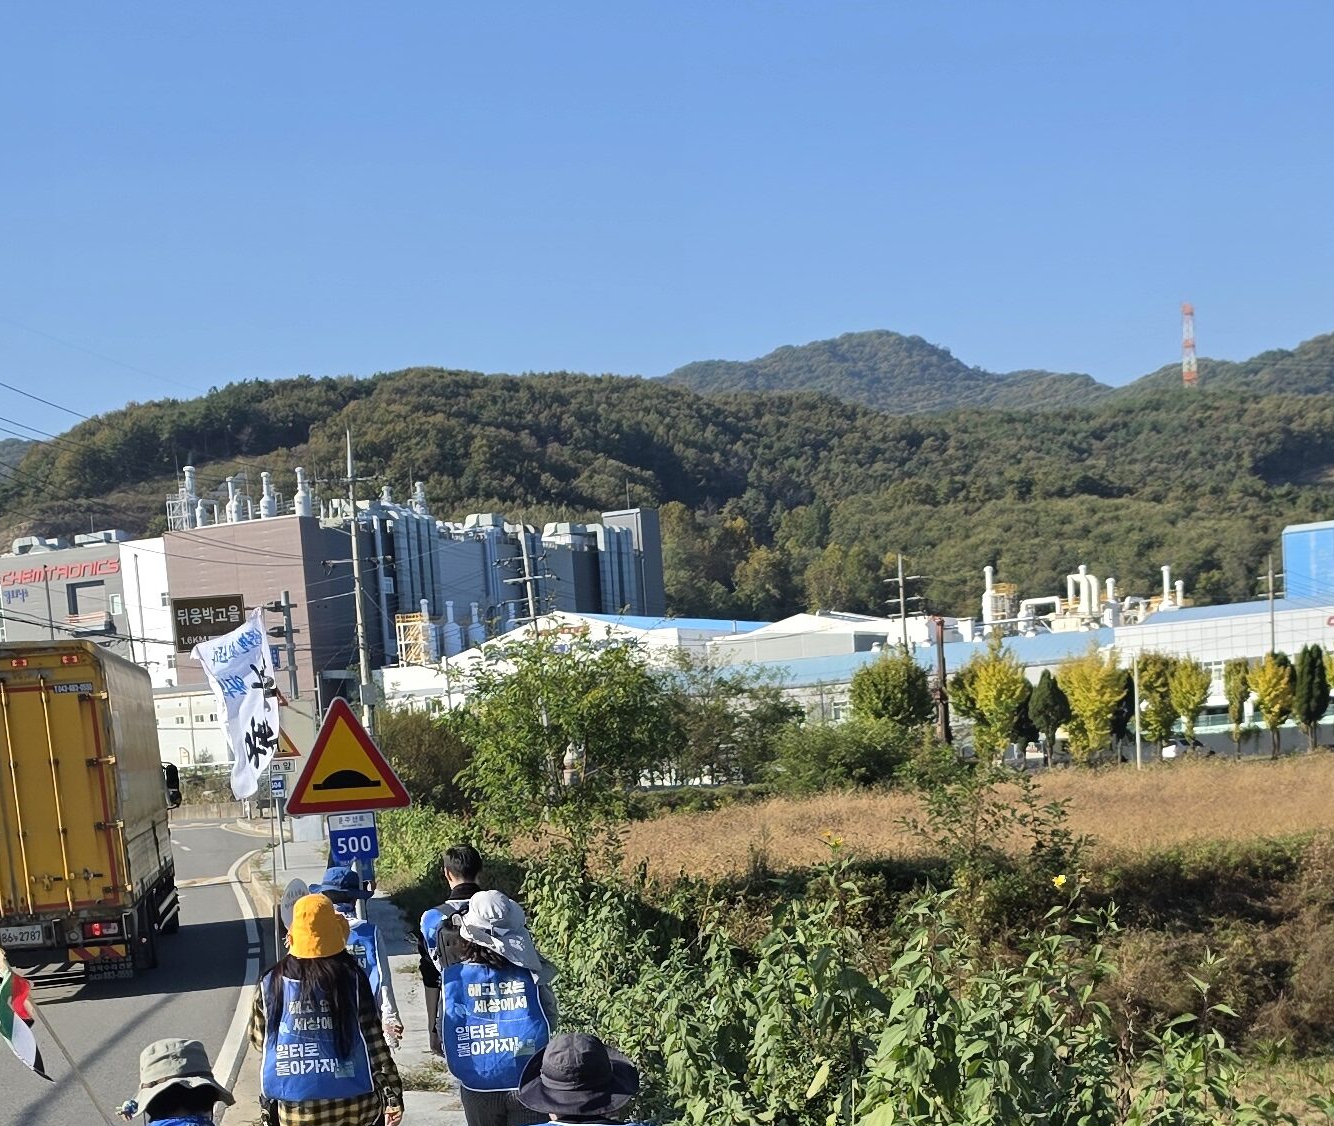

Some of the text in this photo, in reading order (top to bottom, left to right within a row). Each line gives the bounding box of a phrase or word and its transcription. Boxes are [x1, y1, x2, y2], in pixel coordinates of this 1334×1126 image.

[0, 559, 120, 586] CHEMTRONICS
[177, 604, 240, 626] 뒤웅박고을
[337, 835, 372, 854] 500
[468, 980, 526, 997] 해고 없는
[473, 996, 528, 1013] 세상에서
[293, 1017, 333, 1031] 세상에
[455, 1024, 500, 1041] 일터로
[276, 1042, 320, 1060] 일터로
[275, 1058, 340, 1077] 돌아가자!
